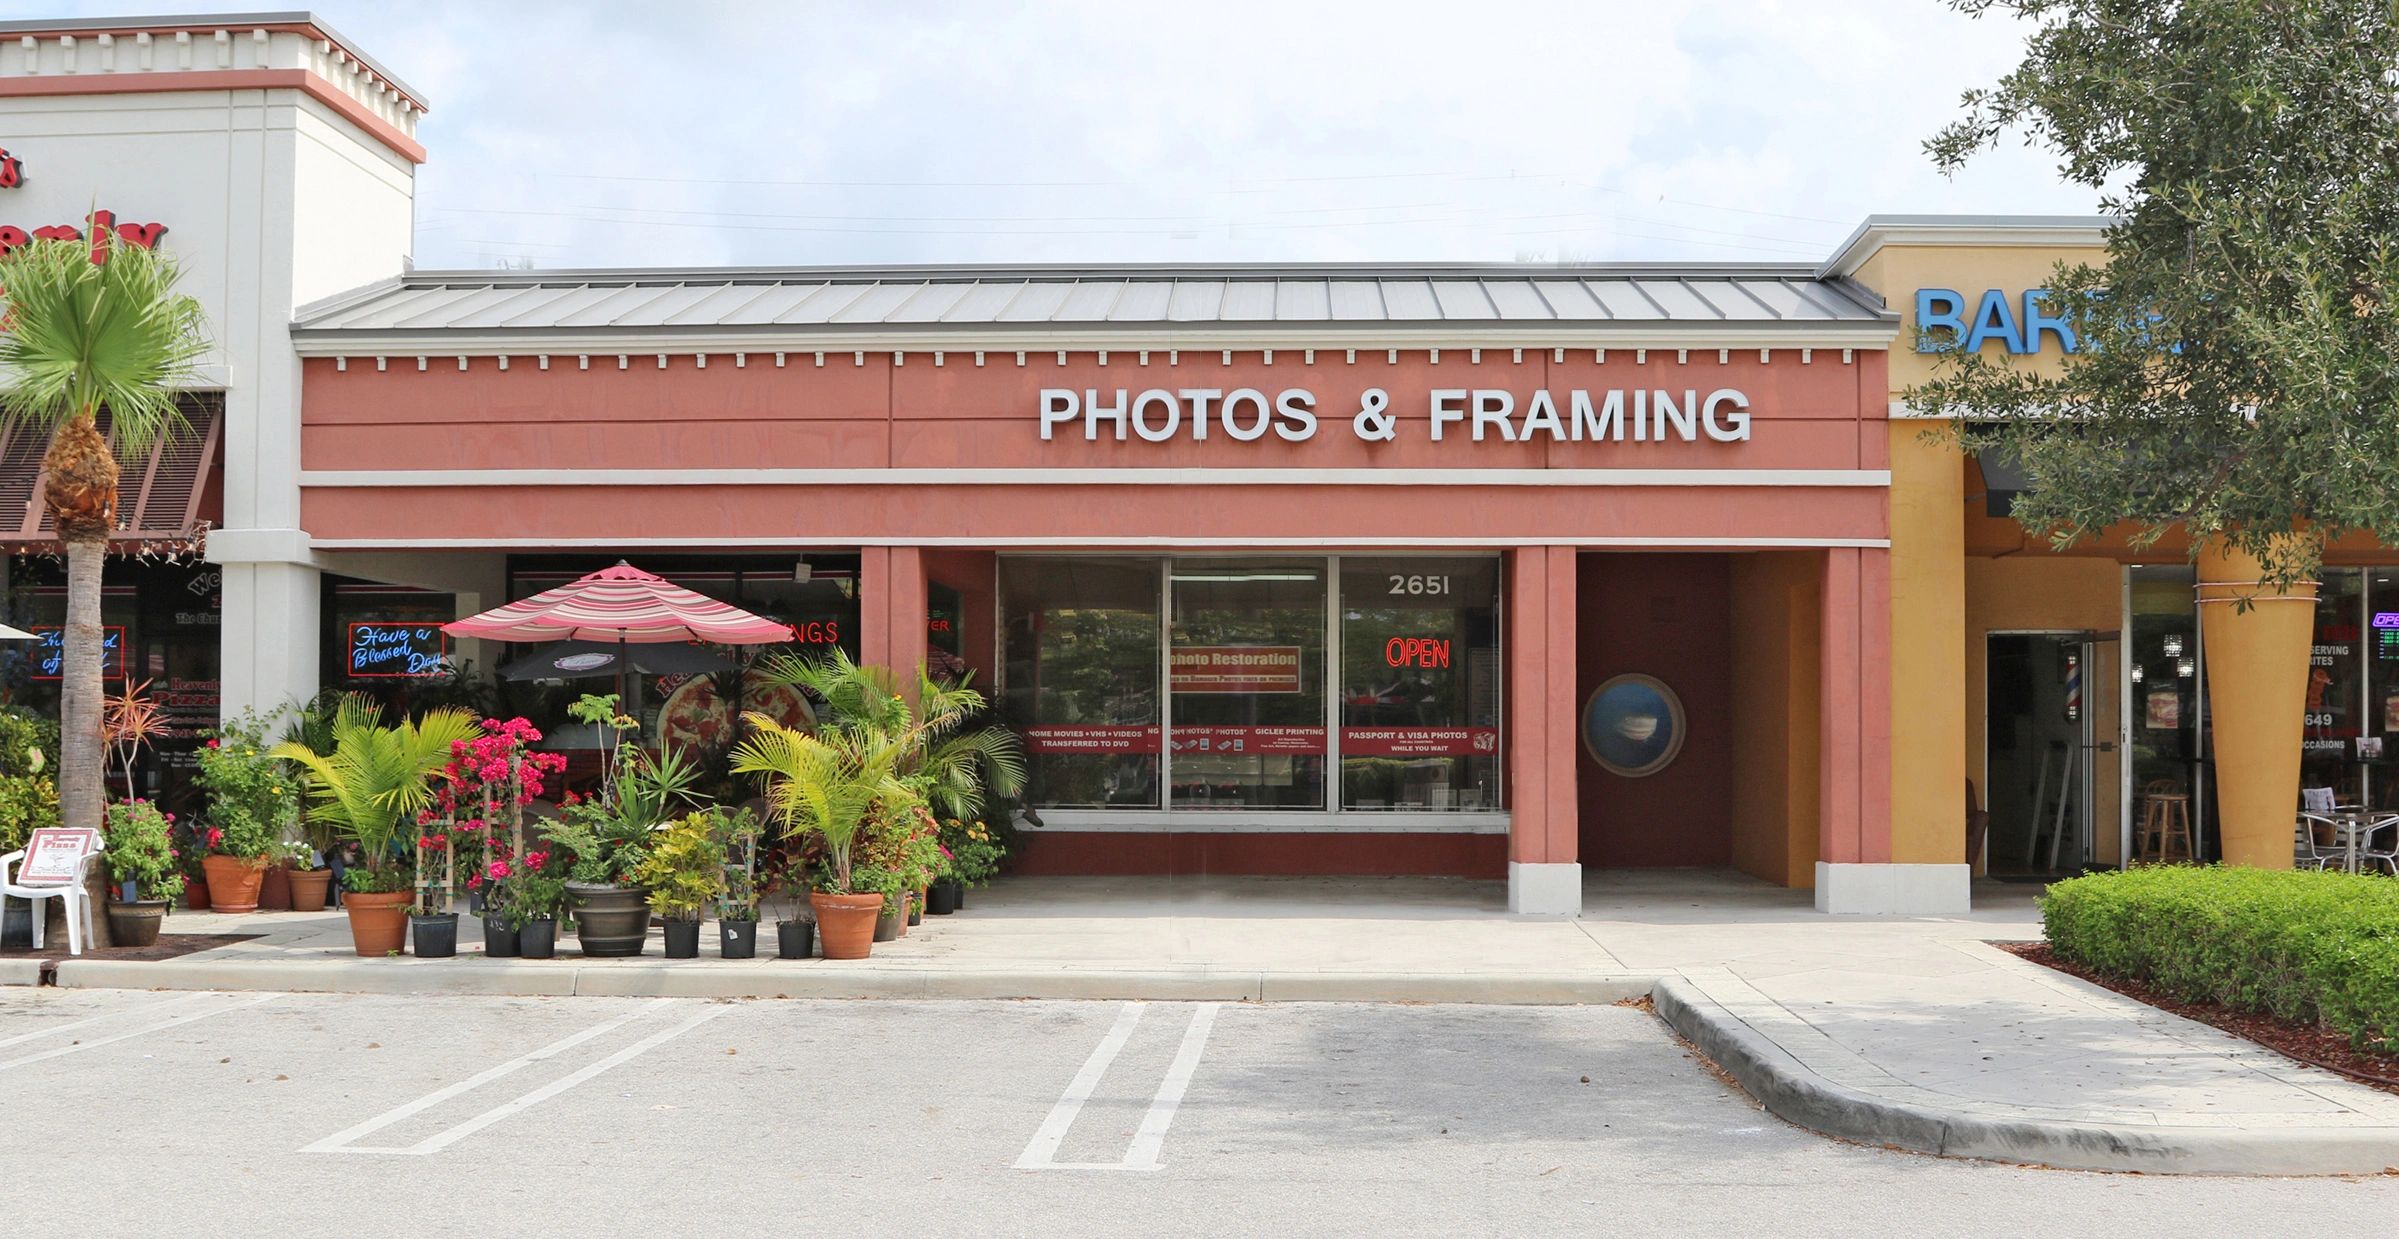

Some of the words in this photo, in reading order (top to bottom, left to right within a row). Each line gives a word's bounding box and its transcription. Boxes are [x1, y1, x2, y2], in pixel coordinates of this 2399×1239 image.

[1915, 289, 2190, 354] BAR
[1040, 388, 1318, 442] PHOTOS
[1353, 388, 1396, 442] &
[1430, 388, 1750, 442] FRAMING
[1388, 575, 1449, 595] 2651
[928, 620, 949, 632] ER
[2375, 615, 2399, 625] OPE
[355, 626, 410, 646] Have
[416, 628, 431, 640] a
[787, 622, 838, 643] NGS
[353, 640, 412, 669] Blessed
[1212, 652, 1297, 666] Restoration
[1386, 637, 1449, 668] OPEN
[2310, 645, 2349, 656] SERVING
[408, 652, 442, 674] Day
[170, 677, 220, 691] Heavenl
[151, 691, 221, 706] Pizza
